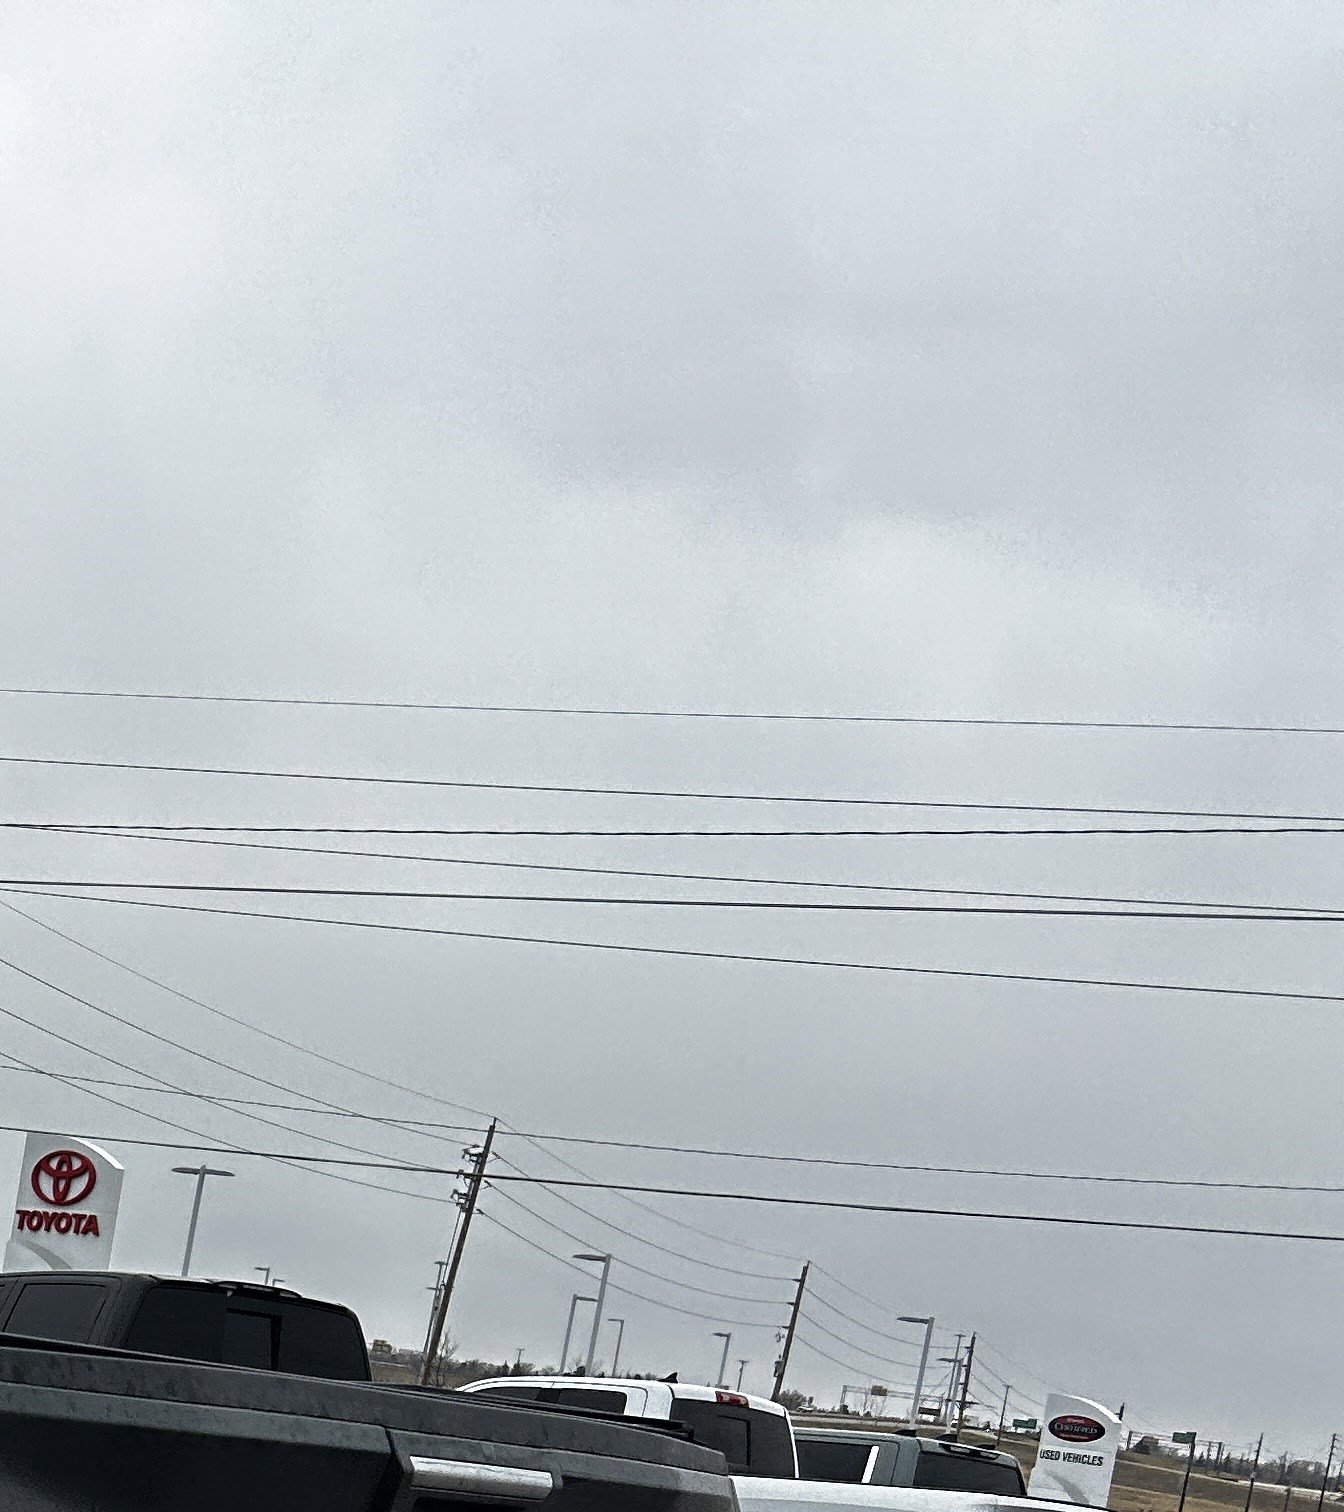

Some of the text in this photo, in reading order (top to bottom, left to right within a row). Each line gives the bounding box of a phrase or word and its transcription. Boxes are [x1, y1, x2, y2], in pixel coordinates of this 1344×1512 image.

[16, 1209, 100, 1238] TOYOTA
[1040, 1449, 1104, 1466] USED VEHICLES
